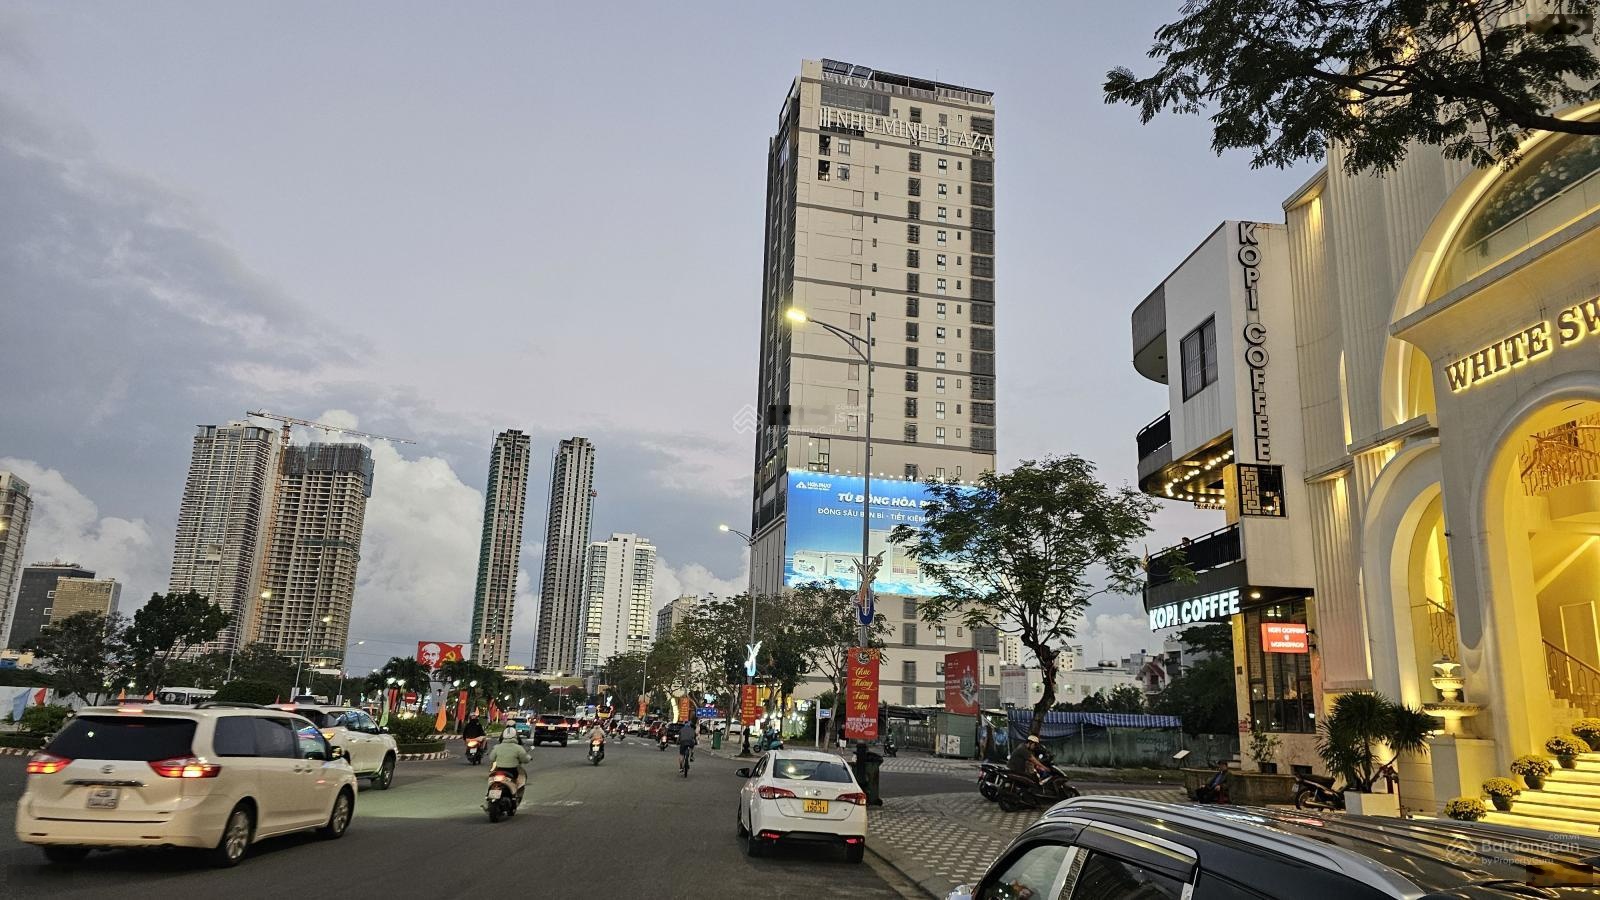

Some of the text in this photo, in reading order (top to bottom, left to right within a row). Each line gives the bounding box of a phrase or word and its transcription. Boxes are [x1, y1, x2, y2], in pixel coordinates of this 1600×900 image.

[881, 118, 930, 141] MINH
[937, 126, 994, 151] PLAZA
[1237, 221, 1262, 311] KOPI
[1243, 322, 1272, 462] COFFEE
[1444, 320, 1552, 393] WHITE
[1181, 590, 1240, 623] COFFEE
